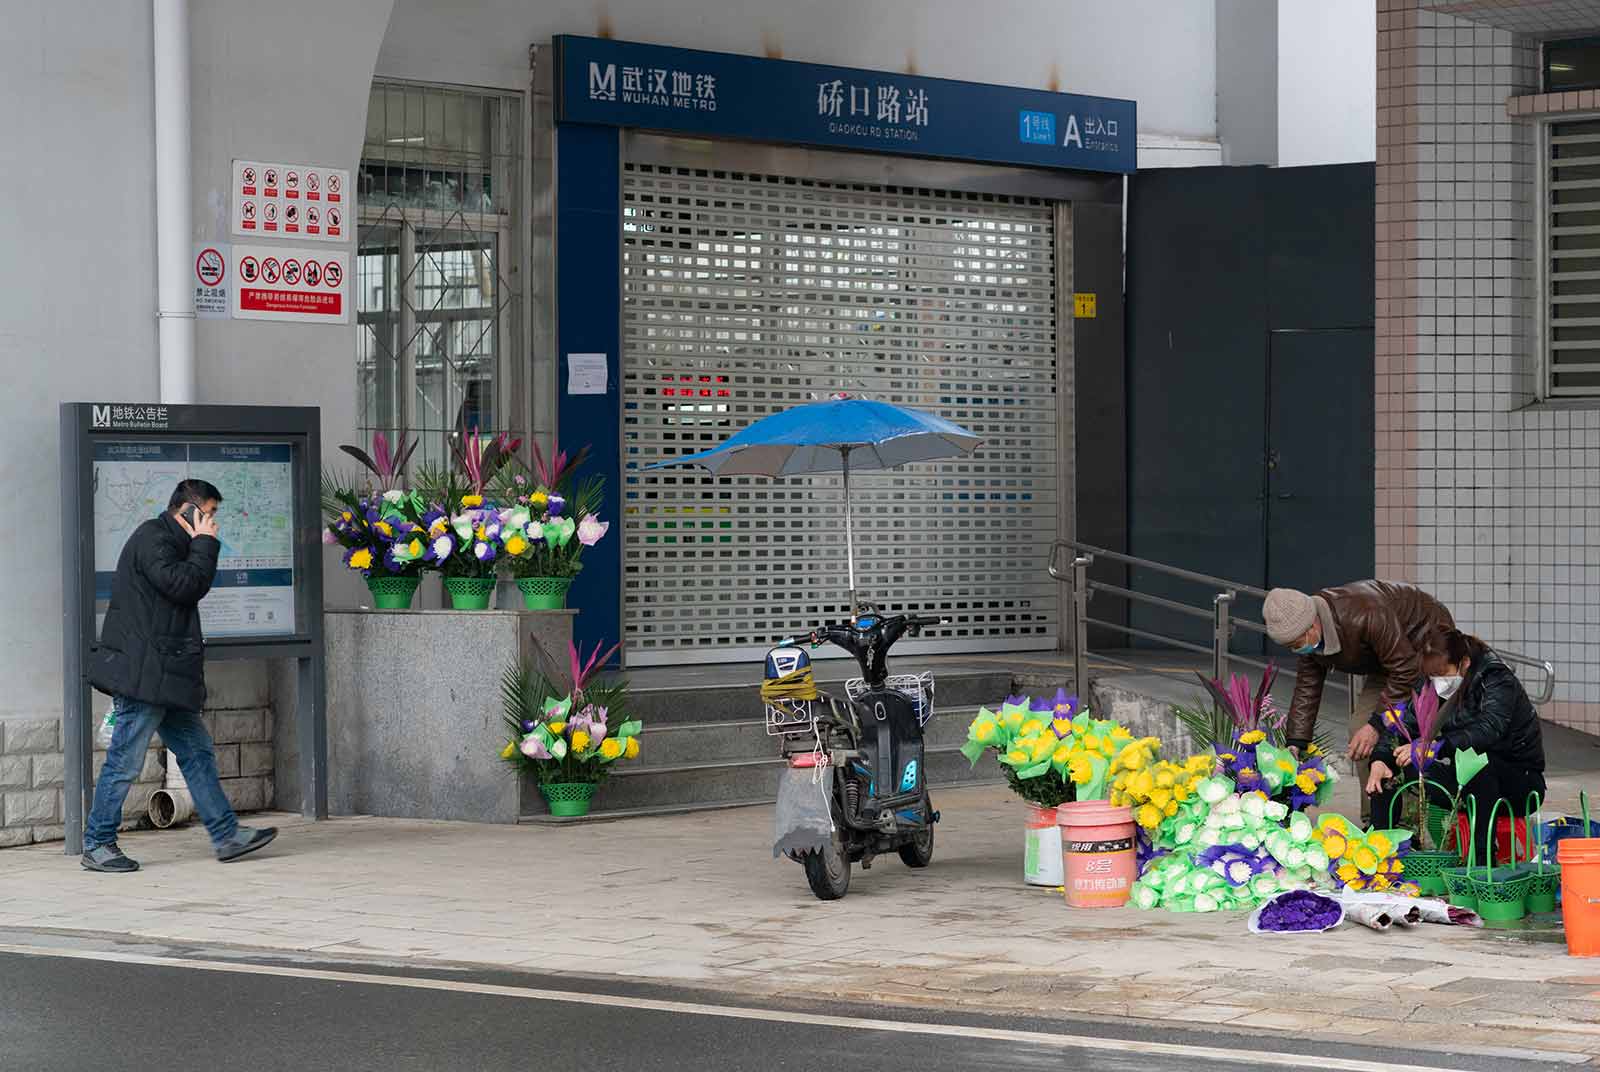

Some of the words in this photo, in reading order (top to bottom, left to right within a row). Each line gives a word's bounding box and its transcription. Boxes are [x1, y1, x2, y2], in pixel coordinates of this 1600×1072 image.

[622, 66, 717, 99] 武汉地铁
[622, 92, 669, 107] WUHAN
[673, 97, 717, 111] METRO
[817, 79, 928, 127] 硚口路站
[829, 122, 868, 136] QIAOKOU
[884, 128, 918, 141] STATION
[1063, 114, 1083, 149] A
[1084, 115, 1118, 136] 出入口
[196, 288, 226, 297] 禁止吸烟
[112, 405, 169, 420] 地铁公告栏
[130, 420, 151, 428] Bulletin
[151, 421, 168, 429] Board
